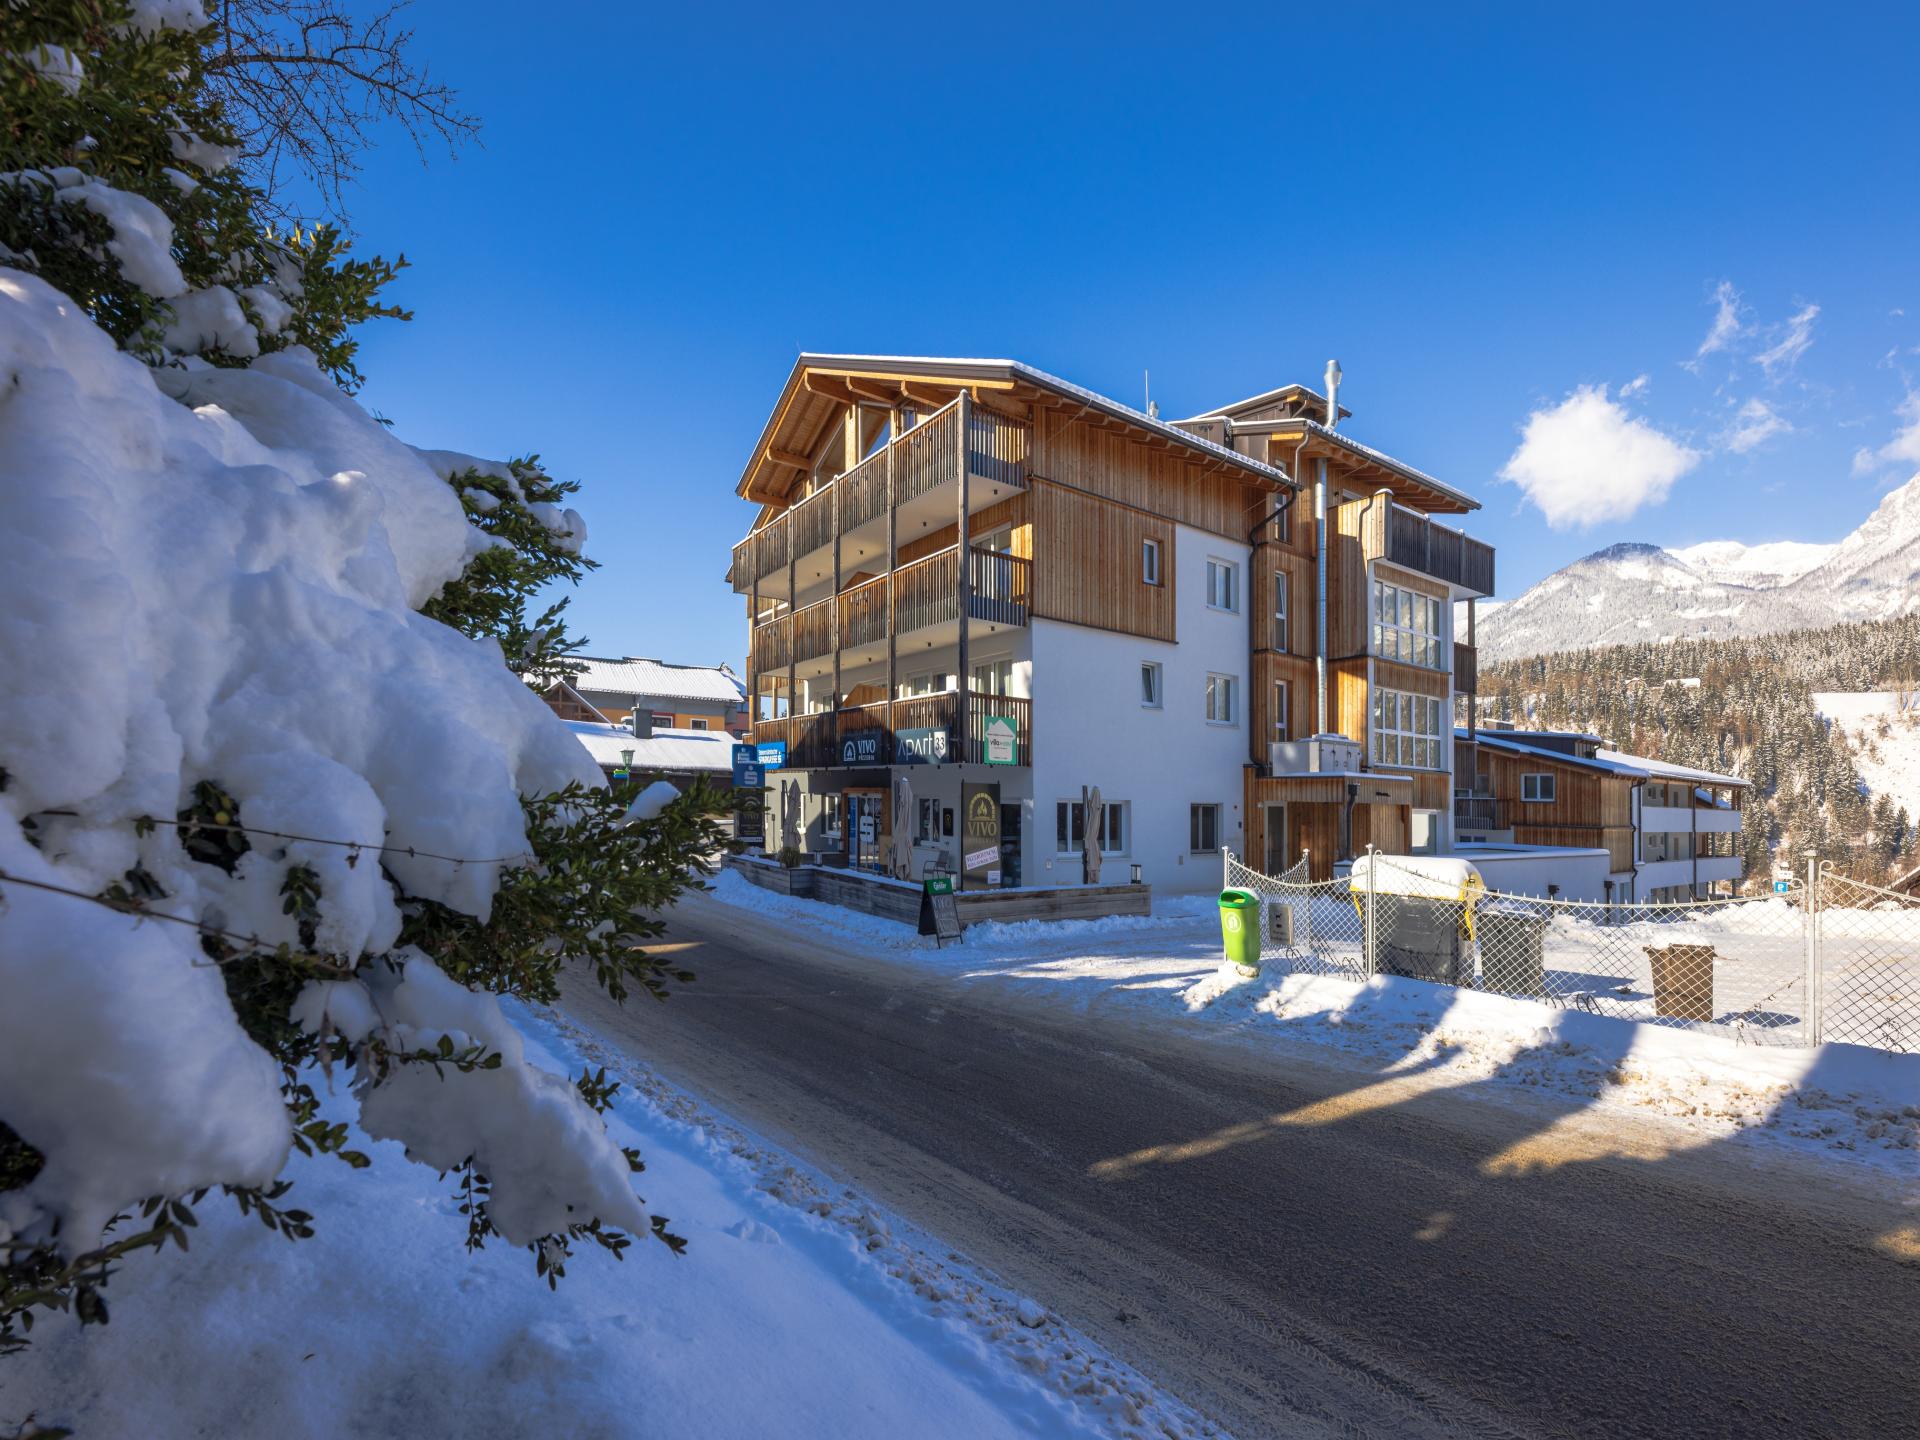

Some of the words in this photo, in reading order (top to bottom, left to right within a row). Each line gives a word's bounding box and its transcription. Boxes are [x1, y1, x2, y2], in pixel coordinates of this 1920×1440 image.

[857, 739, 876, 754] VIVO
[935, 737, 945, 751] 33
[968, 821, 997, 837] VIVO
